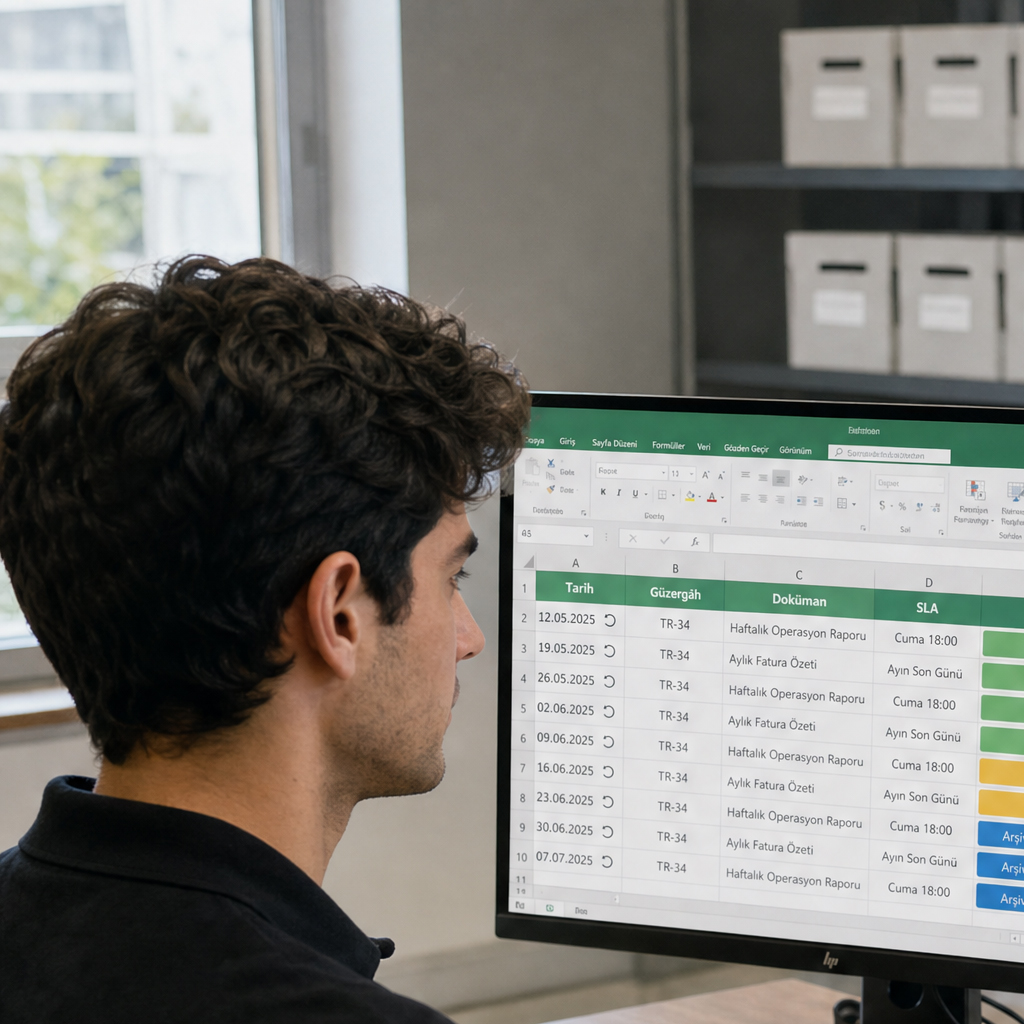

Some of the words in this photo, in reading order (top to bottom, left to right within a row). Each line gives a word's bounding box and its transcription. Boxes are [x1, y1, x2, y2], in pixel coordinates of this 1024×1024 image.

[559, 437, 576, 447] Giriş
[592, 438, 612, 449] Sayfa
[613, 439, 638, 448] Düzeni
[572, 558, 580, 568] A
[672, 563, 679, 574] B
[795, 570, 803, 581] C
[925, 577, 933, 588] D
[565, 582, 594, 594] Tarih
[650, 586, 701, 602] Güzergâh
[772, 593, 827, 607] Doküman
[916, 602, 939, 614] SLA
[539, 611, 596, 625] 12.05.2025
[660, 618, 690, 630] TR-34
[730, 623, 769, 635] Haftalık
[771, 624, 827, 640] Operasyon
[830, 628, 866, 642] Raporu
[894, 632, 925, 645] Cuma
[929, 634, 958, 647] 18:00
[539, 642, 595, 656] 19.05.2025
[660, 649, 690, 661] TR-34
[729, 654, 753, 667] Aylık
[756, 655, 787, 668] Fatura
[790, 655, 817, 670] Özeti
[887, 664, 910, 677] Ayın
[912, 665, 932, 677] Son
[934, 667, 963, 679] Günü
[537, 672, 595, 686] 26.05.2025
[659, 679, 689, 692] TR-34
[729, 685, 767, 697] Haftalık
[770, 687, 826, 703] Operasyon
[829, 691, 865, 705] Raporu
[537, 702, 595, 716] 02.06.2025
[893, 695, 923, 708] Cuma
[927, 698, 956, 711] 18:00
[659, 710, 689, 722] TR-34
[728, 715, 752, 728] Aylık
[755, 717, 786, 730] Fatura
[789, 717, 816, 732] Özeti
[536, 731, 594, 746] 09.06.2025
[885, 727, 908, 740] Ayın
[910, 728, 930, 740] Son
[932, 730, 961, 743] Günü
[658, 740, 688, 752] TR-34
[728, 746, 766, 759] Haftalık
[769, 749, 825, 765] Operasyon
[828, 754, 864, 768] Raporu
[538, 762, 594, 776] 16.06.2025
[891, 758, 921, 771] Cuma
[926, 761, 955, 774] 18:00
[658, 770, 688, 783] TR-34
[727, 776, 751, 790] Aylık
[754, 778, 785, 791] Fatura
[788, 780, 815, 794] Özeti
[536, 791, 594, 806] 23.06.2025
[883, 789, 906, 803] Ayın
[909, 791, 928, 802] Son
[931, 792, 959, 805] Günü
[657, 801, 687, 813] TR-34
[727, 807, 765, 820] Haftalık
[768, 810, 824, 827] Operasyon
[826, 815, 863, 829] Raporu
[536, 821, 594, 836] 30.06.2025
[889, 820, 920, 833] Cuma
[924, 823, 953, 836] 18:00
[657, 831, 687, 843] TR-34
[726, 837, 750, 851] Aylık
[753, 839, 784, 853] Fatura
[786, 841, 814, 855] Özeti
[535, 850, 593, 866] 07.07.2025
[881, 851, 904, 864] Ayın
[907, 853, 926, 864] Son
[929, 855, 958, 868] Günü
[656, 861, 687, 873] TR-34
[726, 868, 764, 881] Haftalık
[766, 871, 822, 888] Operasyon
[825, 877, 861, 891] Raporu
[888, 882, 918, 895] Cuma
[922, 885, 951, 898] 18:00
